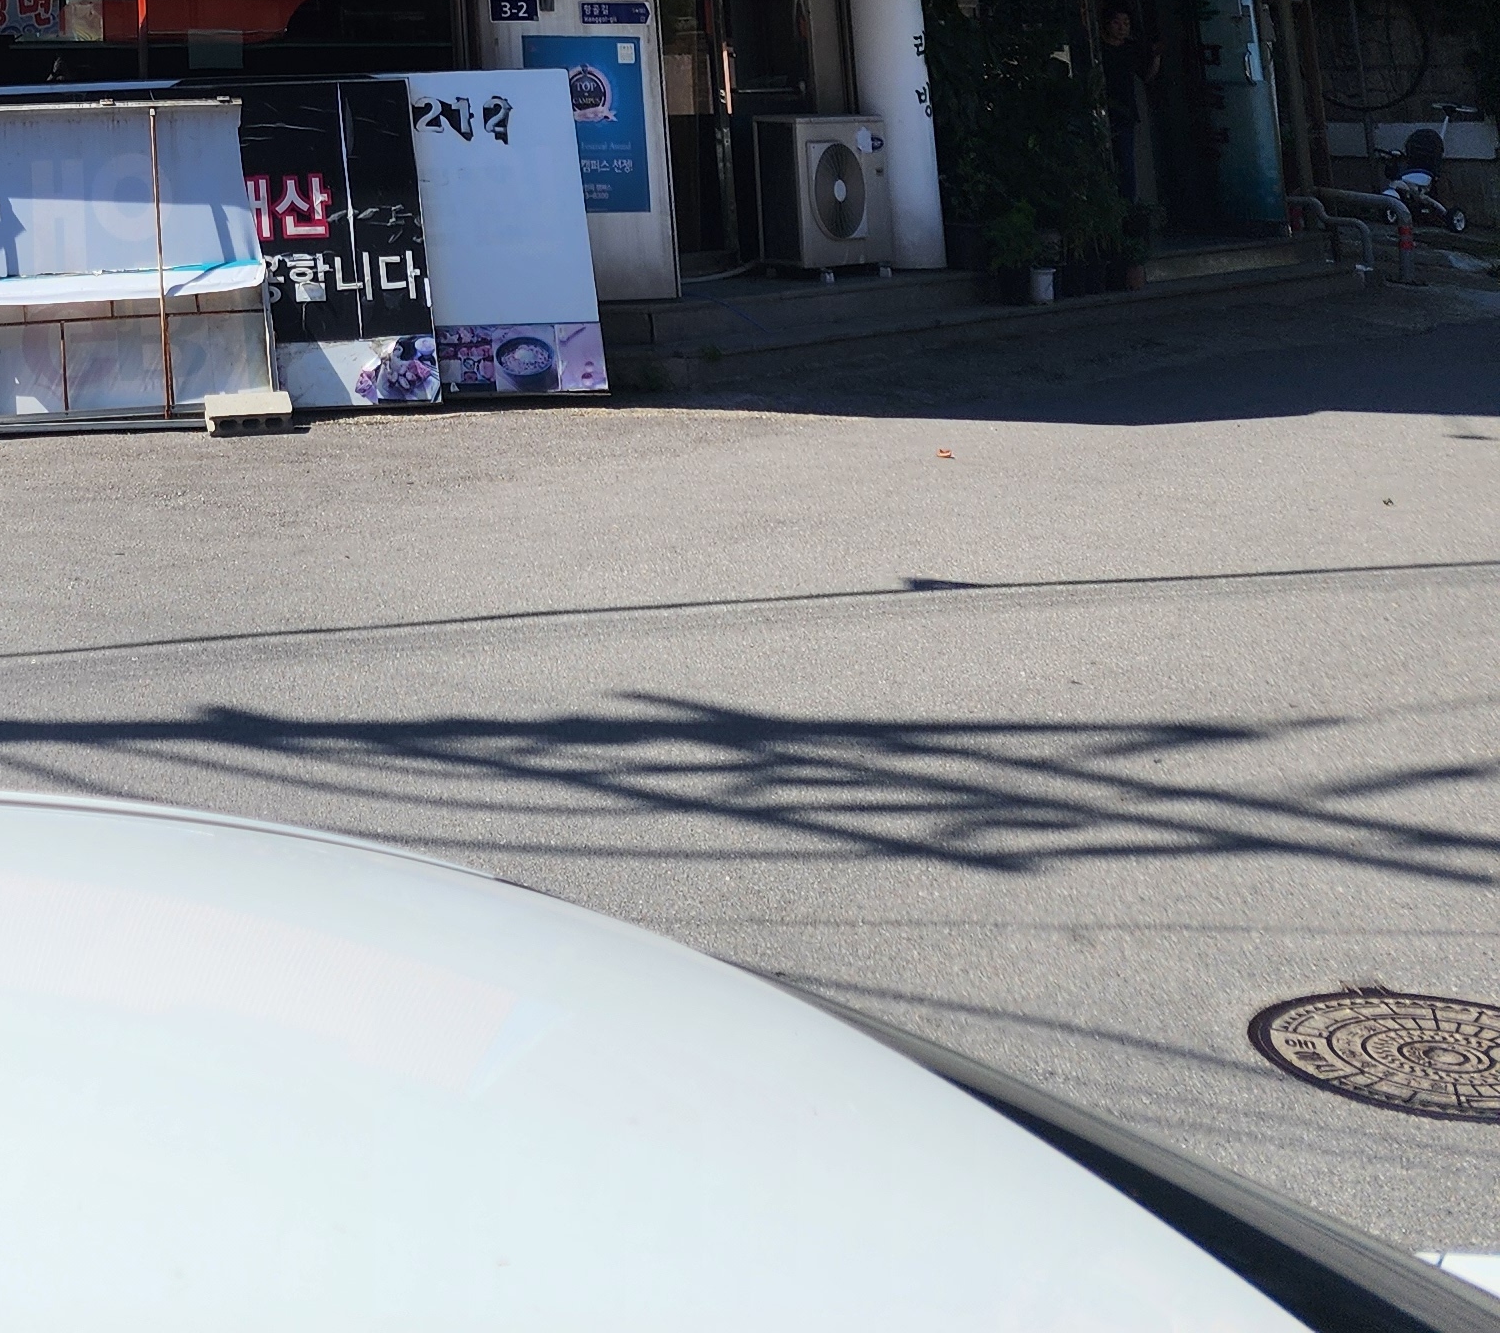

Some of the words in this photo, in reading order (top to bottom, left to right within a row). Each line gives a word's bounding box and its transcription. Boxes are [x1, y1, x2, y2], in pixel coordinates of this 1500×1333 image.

[501, 2, 528, 17] 3-2
[577, 81, 597, 92] TOP
[573, 97, 600, 105] CAMPUS
